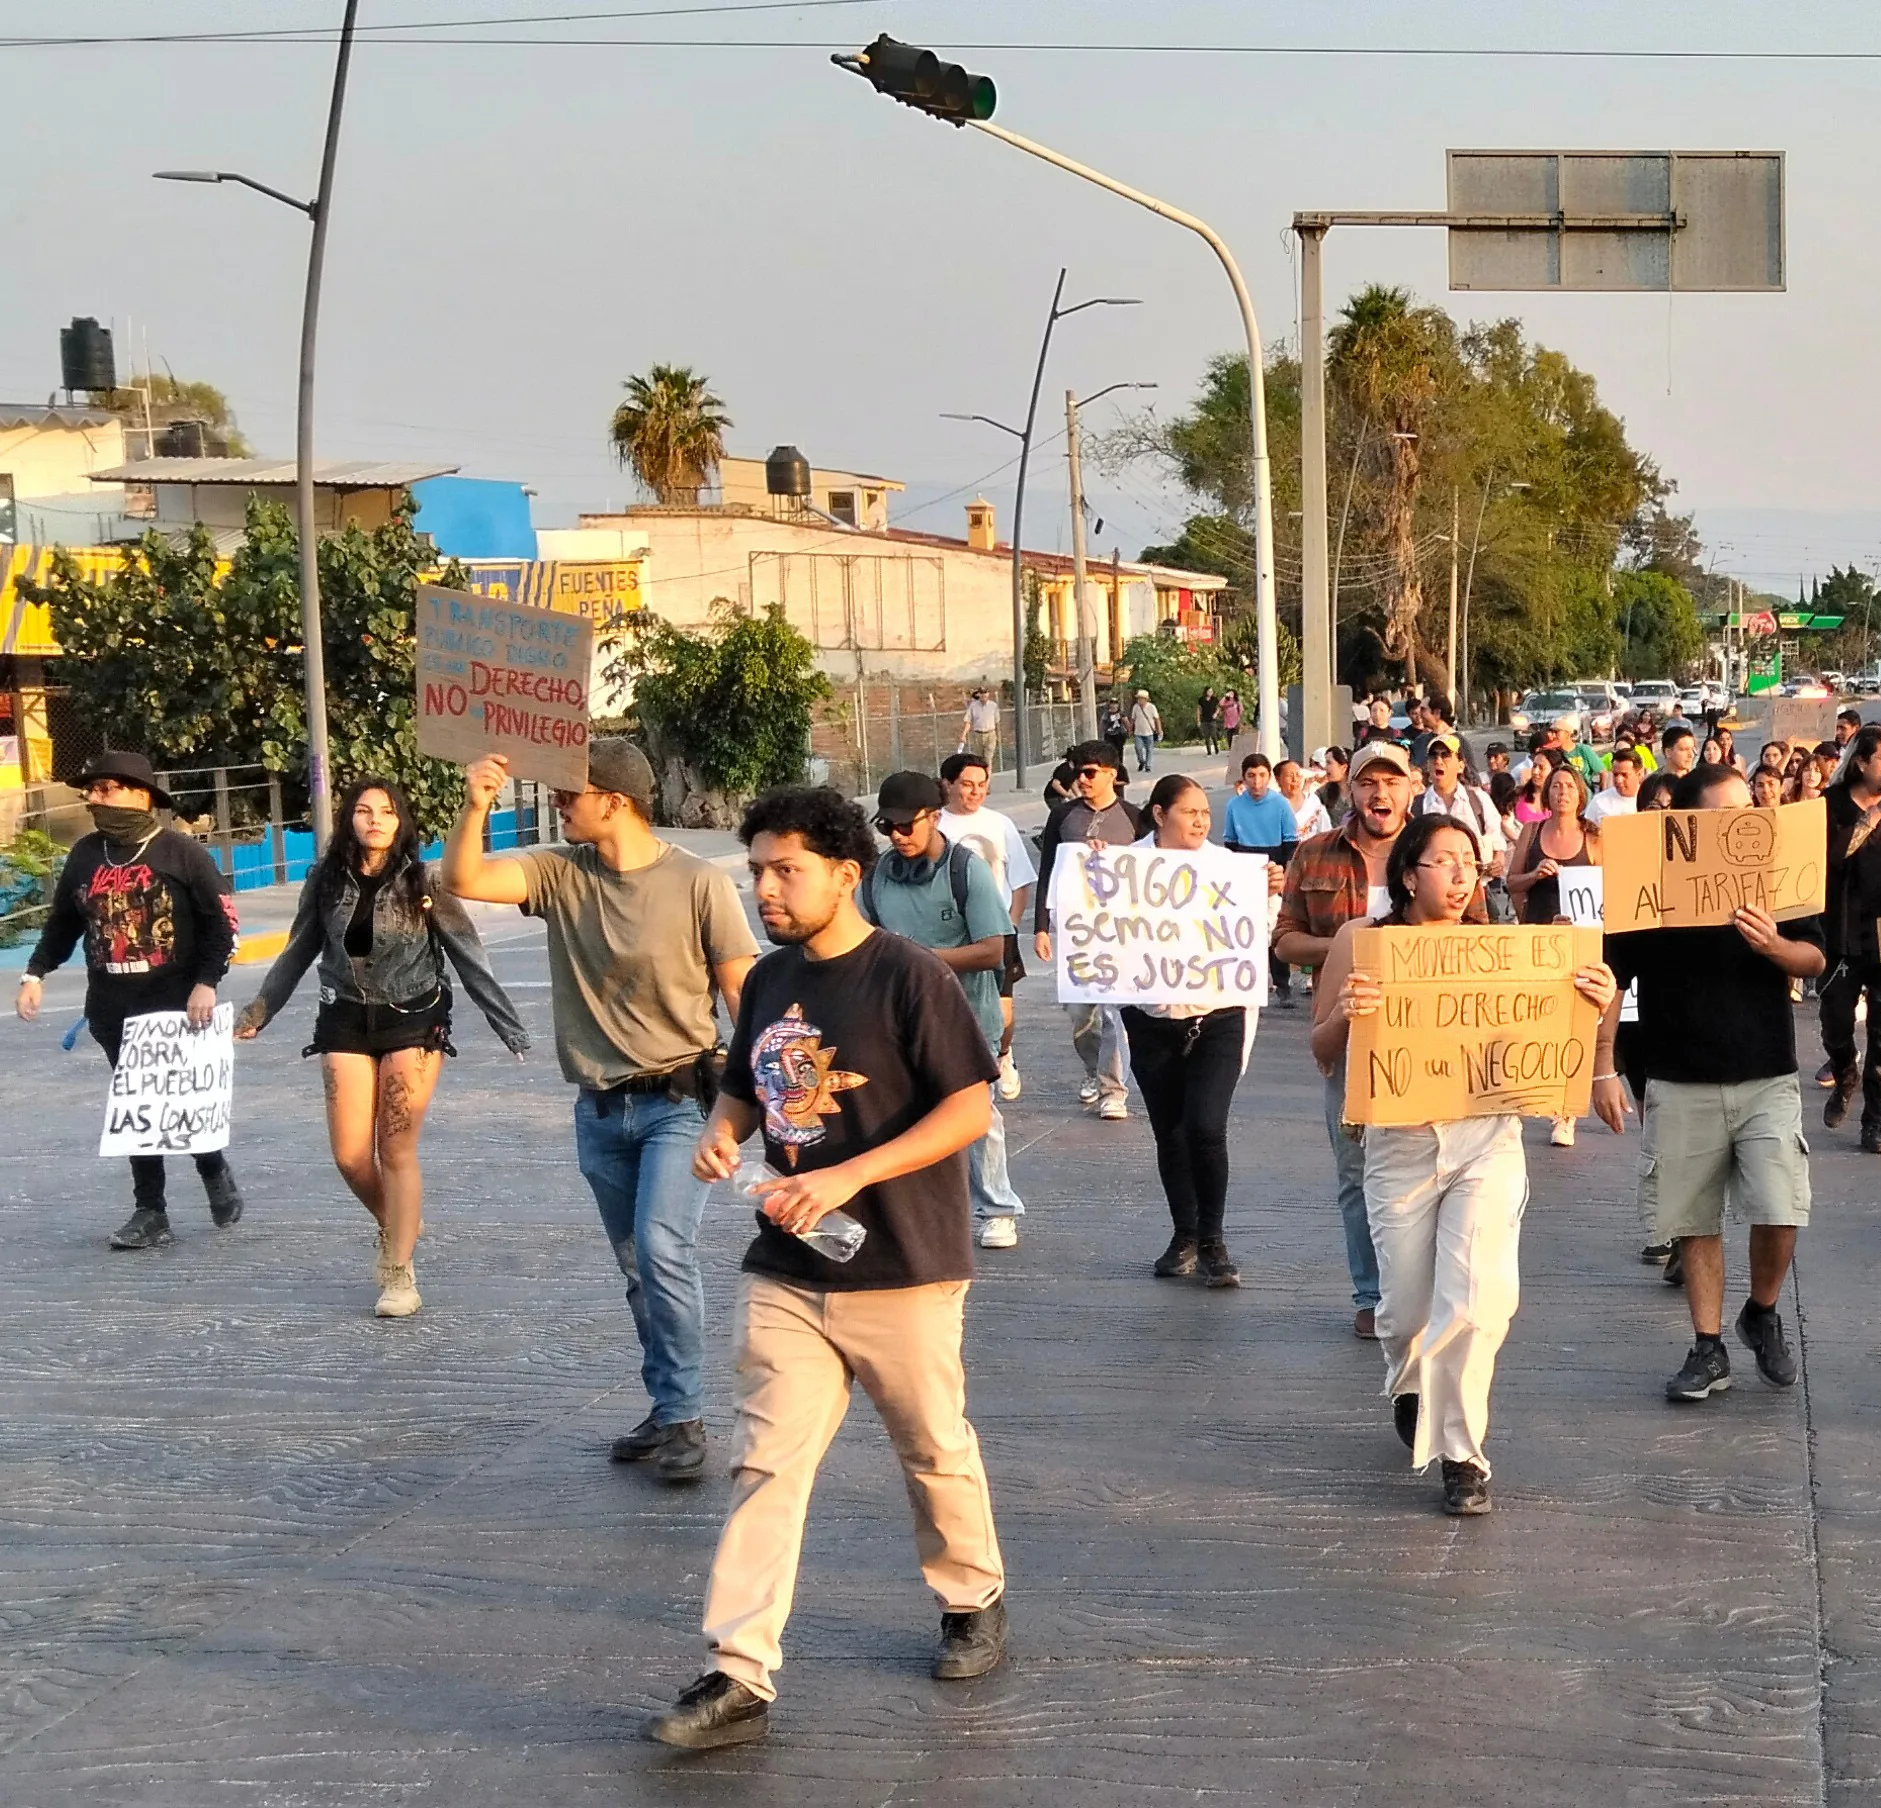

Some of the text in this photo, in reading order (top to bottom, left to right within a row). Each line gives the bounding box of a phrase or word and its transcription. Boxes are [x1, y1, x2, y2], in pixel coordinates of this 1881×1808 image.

[560, 570, 639, 595] FUENTES
[428, 598, 581, 648] TRANSPORTE
[579, 597, 624, 620] PEÑA
[469, 661, 587, 711] DERECHO,
[425, 683, 588, 748] NO PRIVILEGIO
[88, 864, 154, 898] SLAYER
[1082, 850, 1198, 910] $960
[1635, 883, 1676, 921] AL
[1203, 915, 1256, 952] NO
[1531, 934, 1568, 970] ES
[1066, 952, 1257, 993] ES JUSTO
[1436, 992, 1559, 1029] DERECHO
[112, 1071, 138, 1097] EL
[141, 1063, 215, 1097] PUEBLO
[1370, 1046, 1413, 1100] NO
[1460, 1037, 1585, 1095] NEGOCIO
[109, 1103, 153, 1135] LAS
